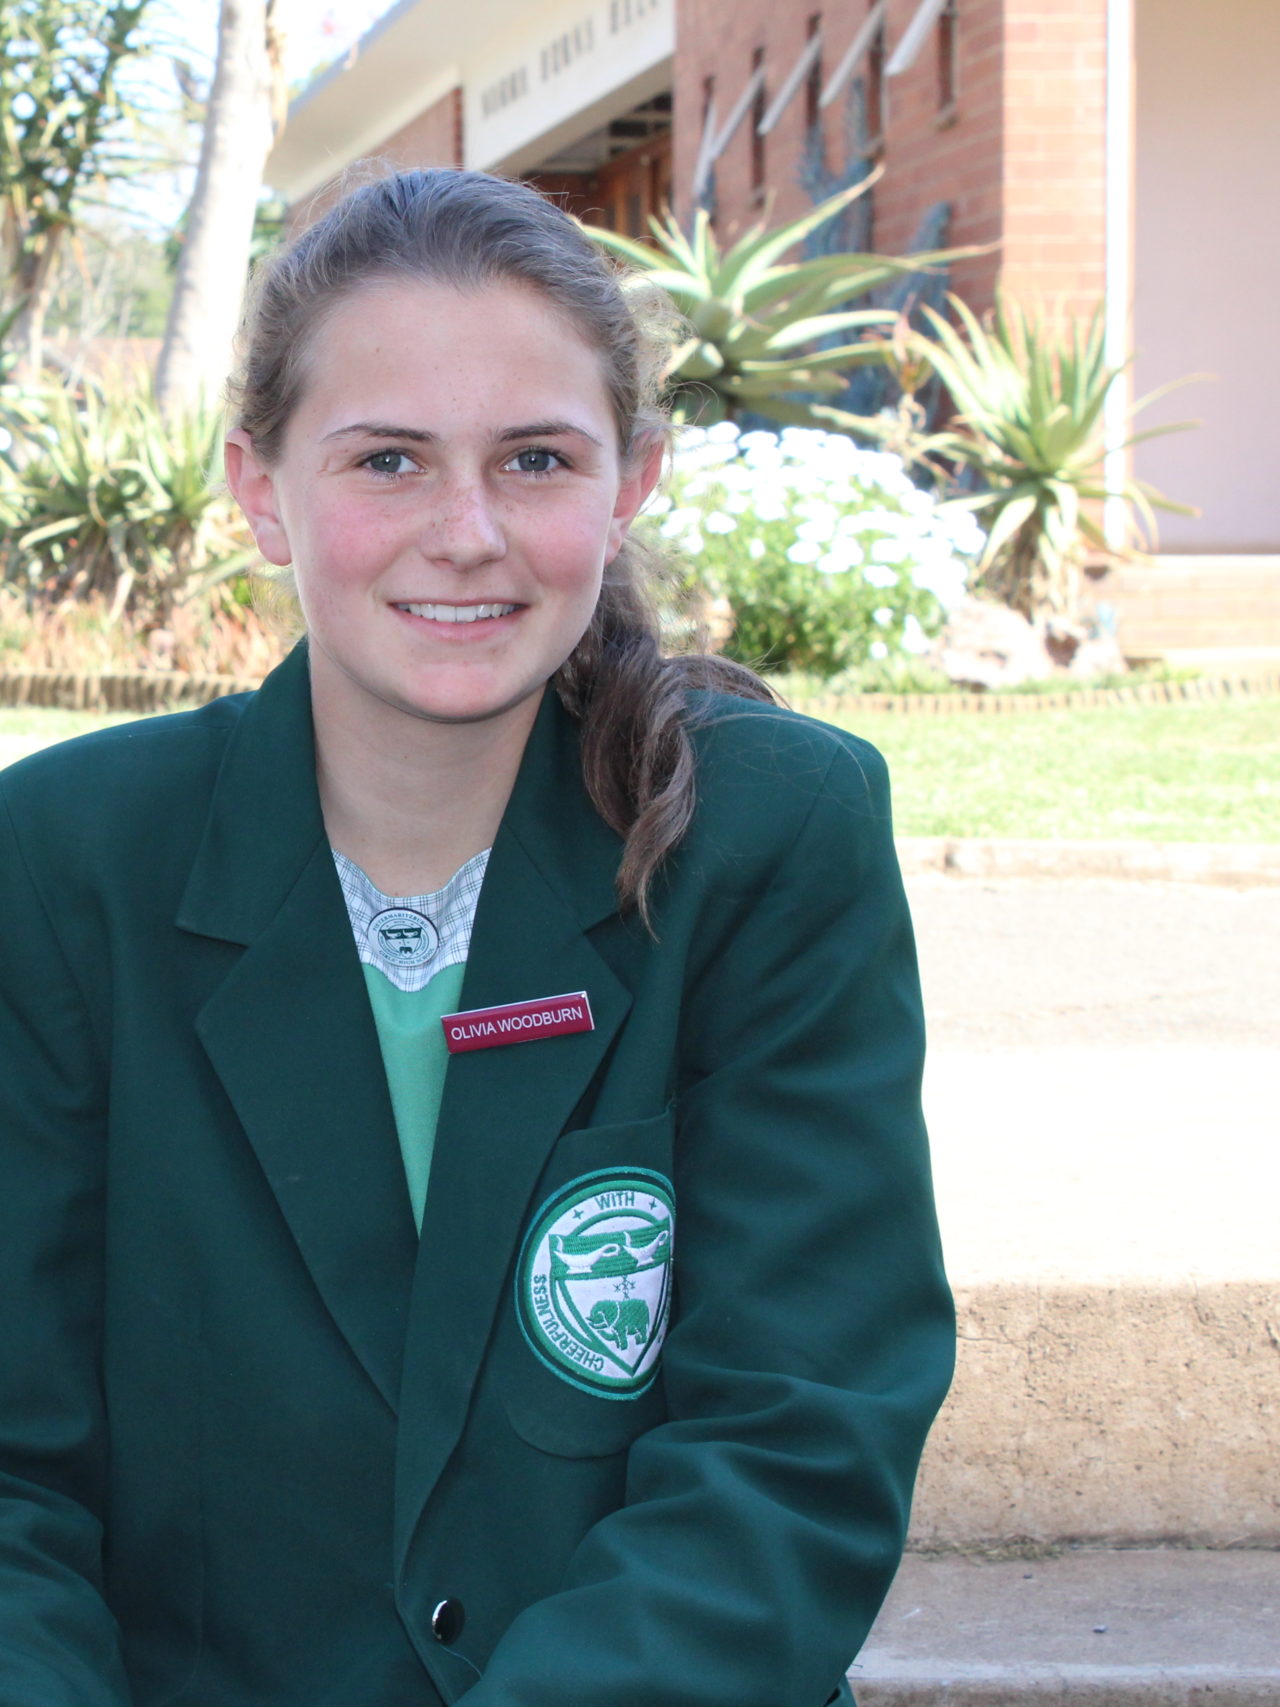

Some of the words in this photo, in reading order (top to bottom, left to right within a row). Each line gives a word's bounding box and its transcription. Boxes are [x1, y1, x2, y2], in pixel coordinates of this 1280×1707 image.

[450, 1022, 496, 1041] OLIVIA
[497, 1006, 583, 1032] WOODBURN
[594, 1191, 636, 1211] WITH
[533, 1274, 605, 1372] CHEERFULNESS
